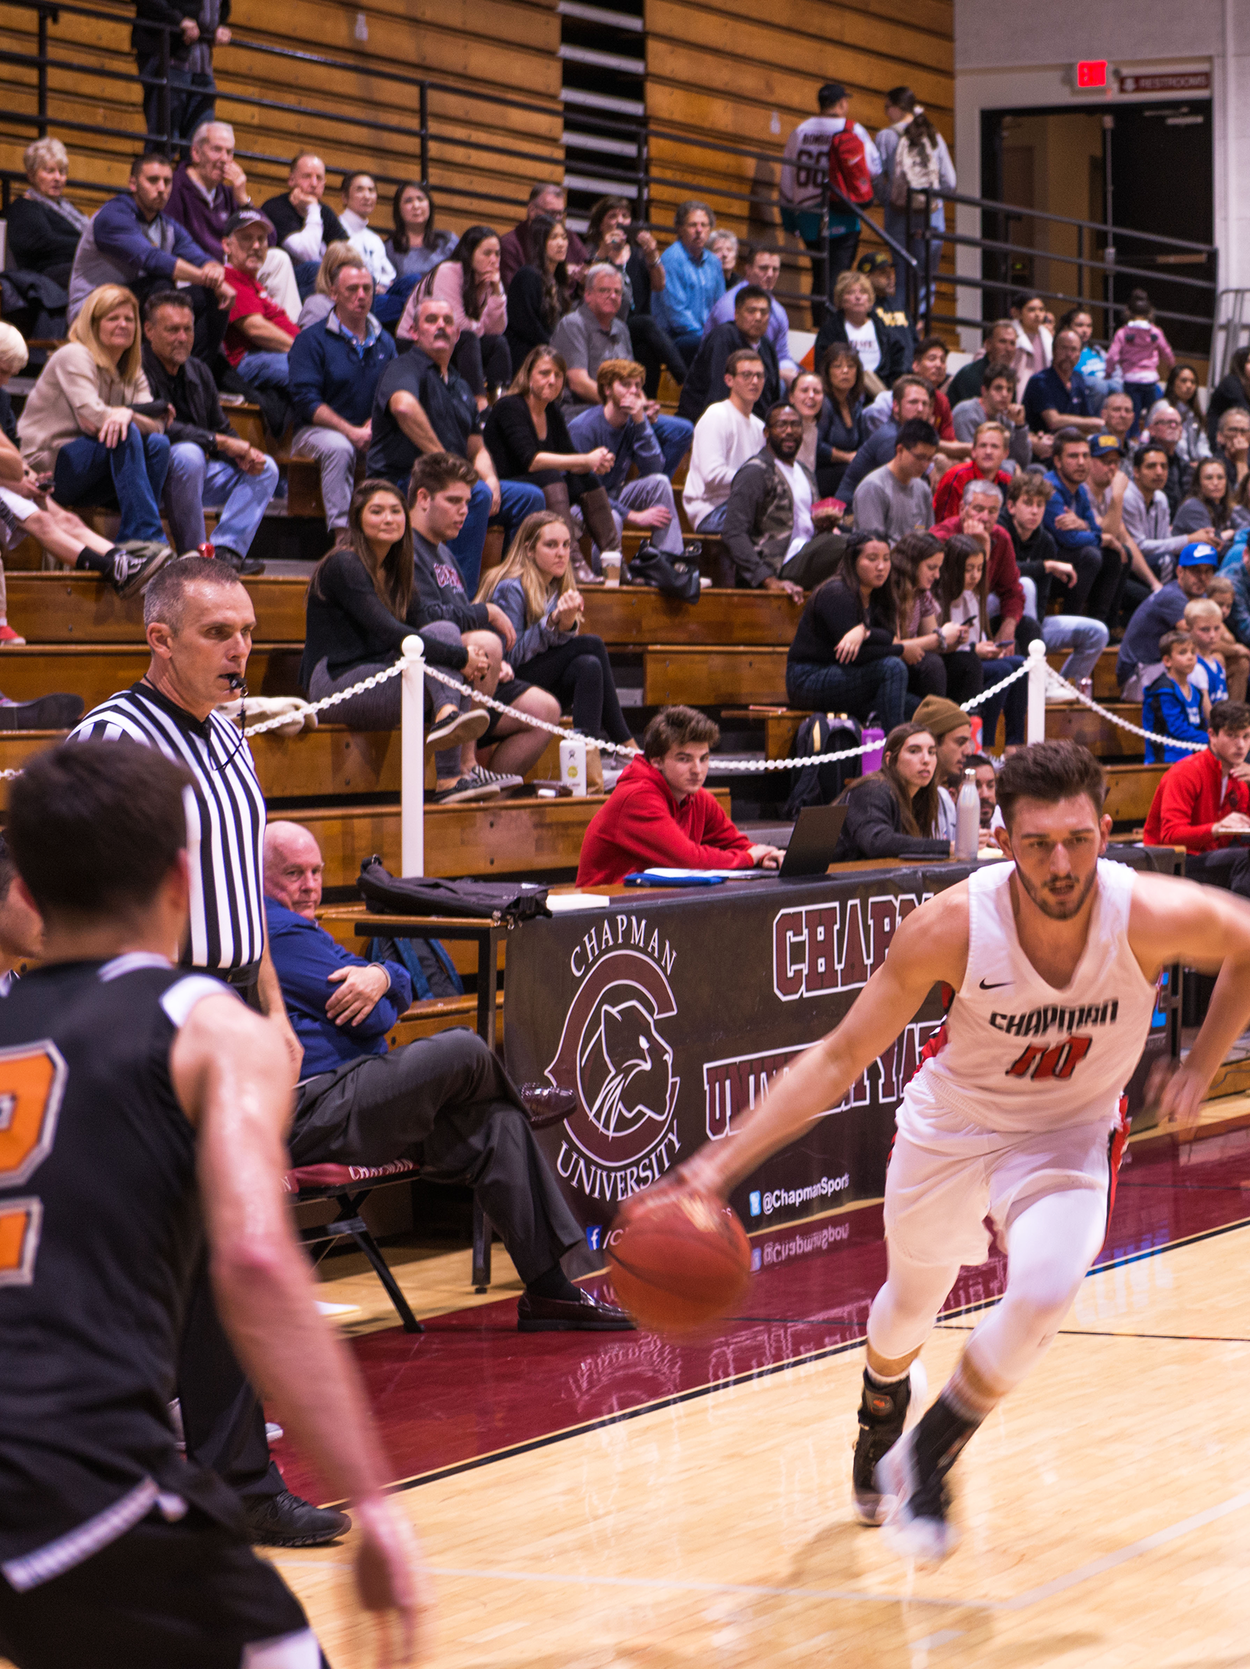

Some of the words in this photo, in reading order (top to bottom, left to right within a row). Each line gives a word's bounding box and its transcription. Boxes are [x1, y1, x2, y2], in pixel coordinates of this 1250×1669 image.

[570, 914, 677, 977] CHAPMAN
[988, 997, 1119, 1038] CHAPMAN
[1005, 1032, 1093, 1082] 10
[557, 1118, 682, 1202] UNIVERSITY
